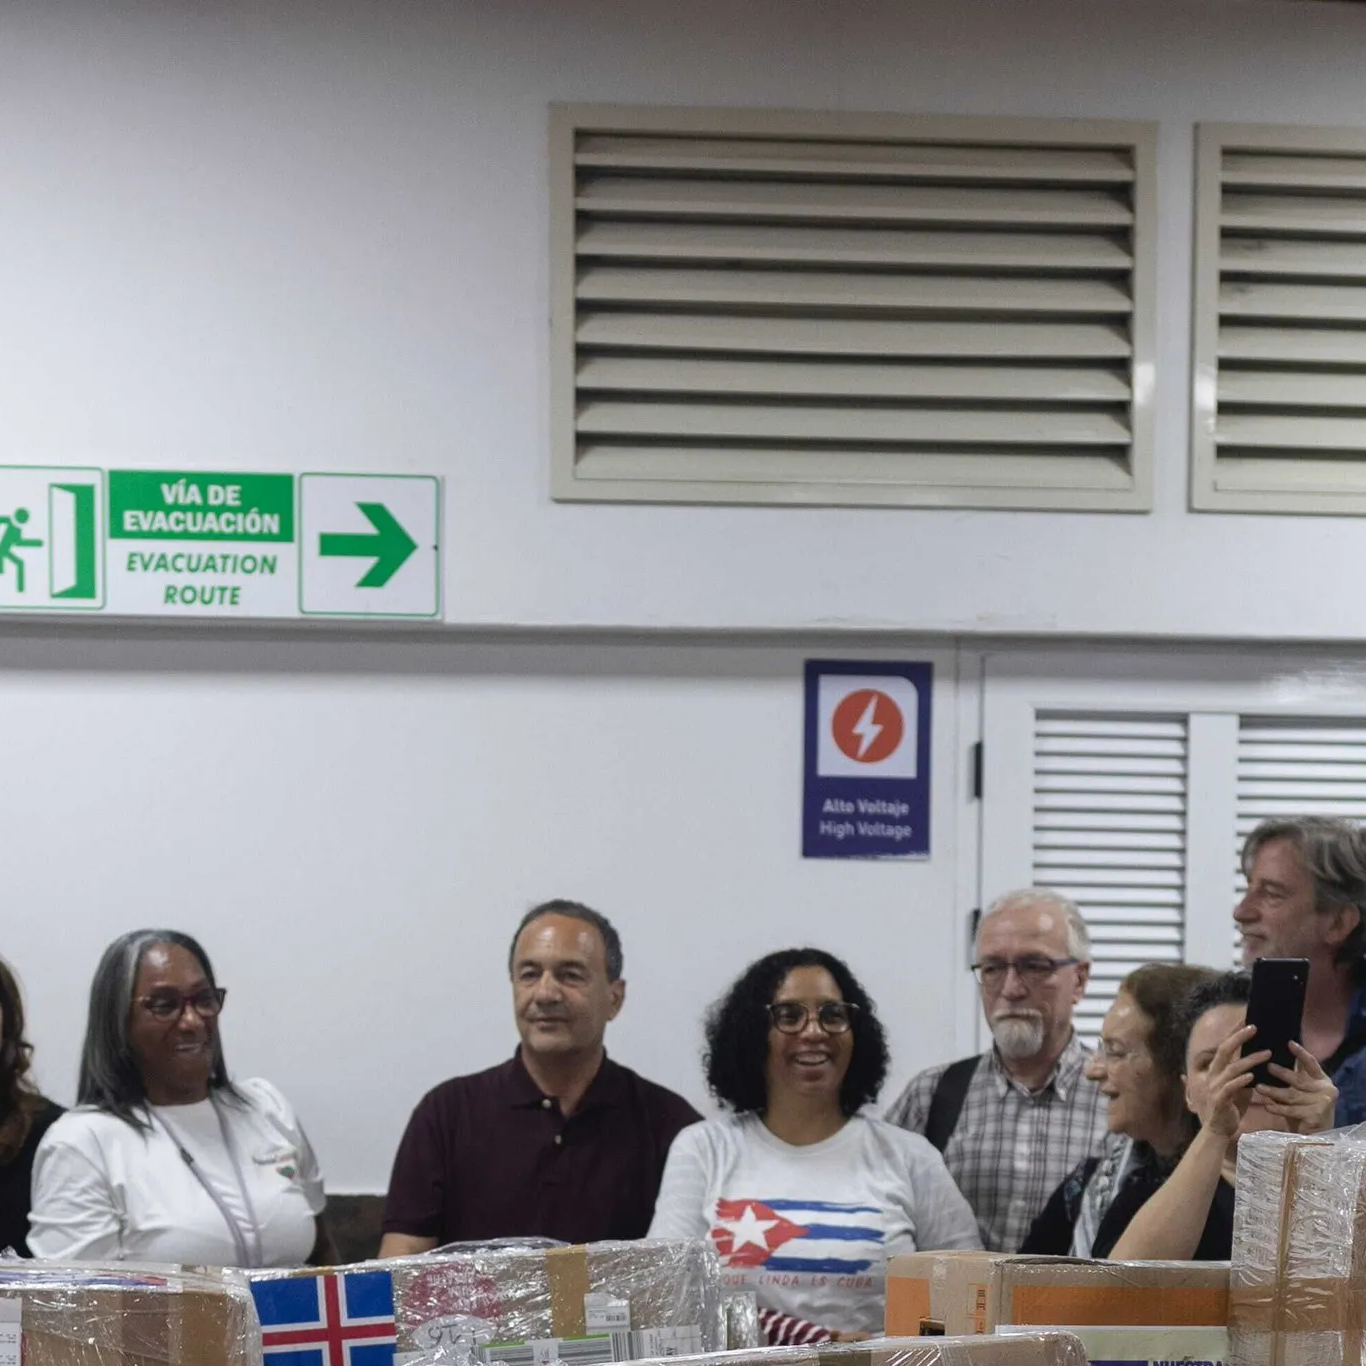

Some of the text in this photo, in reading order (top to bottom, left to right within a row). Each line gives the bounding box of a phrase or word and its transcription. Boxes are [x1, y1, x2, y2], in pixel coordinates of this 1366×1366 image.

[160, 477, 242, 507] VÍA DE
[123, 507, 281, 535] EVACUACIÓN
[126, 552, 278, 575] EVACUATION
[164, 584, 241, 606] ROUTE
[822, 799, 910, 818] Alto Voltaje
[819, 820, 912, 842] High Voltage
[759, 1275, 800, 1286] LINDA
[811, 1275, 831, 1287] ES
[837, 1276, 874, 1288] CUBA
